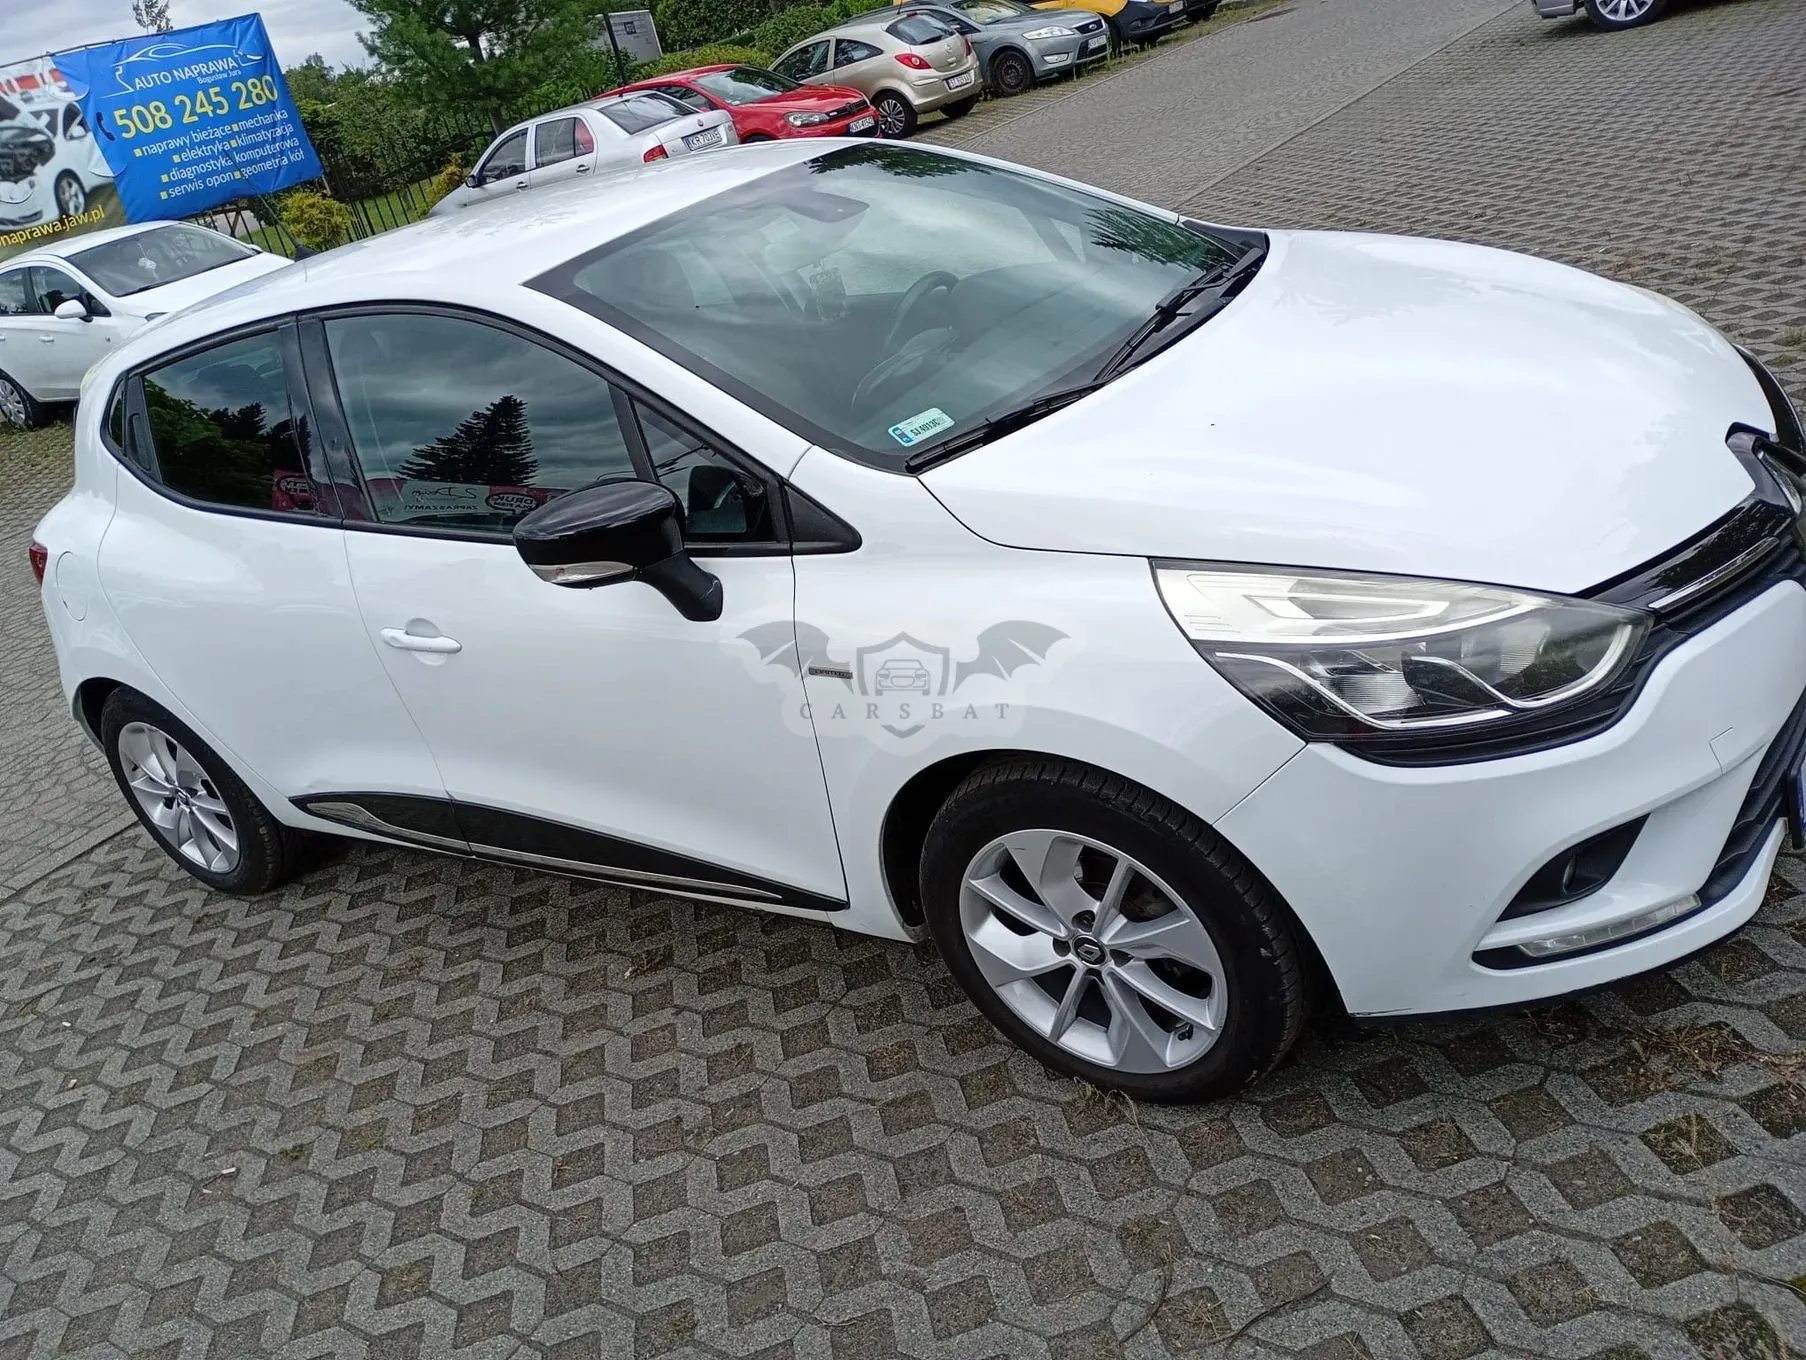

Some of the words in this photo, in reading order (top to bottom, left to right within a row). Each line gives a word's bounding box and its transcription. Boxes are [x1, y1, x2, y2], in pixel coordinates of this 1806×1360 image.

[135, 71, 172, 91] AUTO
[172, 57, 238, 81] NAPRAWA
[113, 100, 173, 139] 508
[174, 86, 230, 124] 245
[231, 75, 278, 110] 280
[142, 135, 191, 156] naprawy
[191, 124, 232, 143] bieżące
[170, 155, 233, 182] diagnostyka
[234, 136, 299, 163] komputerowa
[181, 140, 231, 162] elektryka
[237, 122, 294, 147] klimatyzacja
[169, 178, 204, 198] serwis
[206, 171, 234, 191] opon
[0, 204, 105, 248] naprawa.jaw.pl
